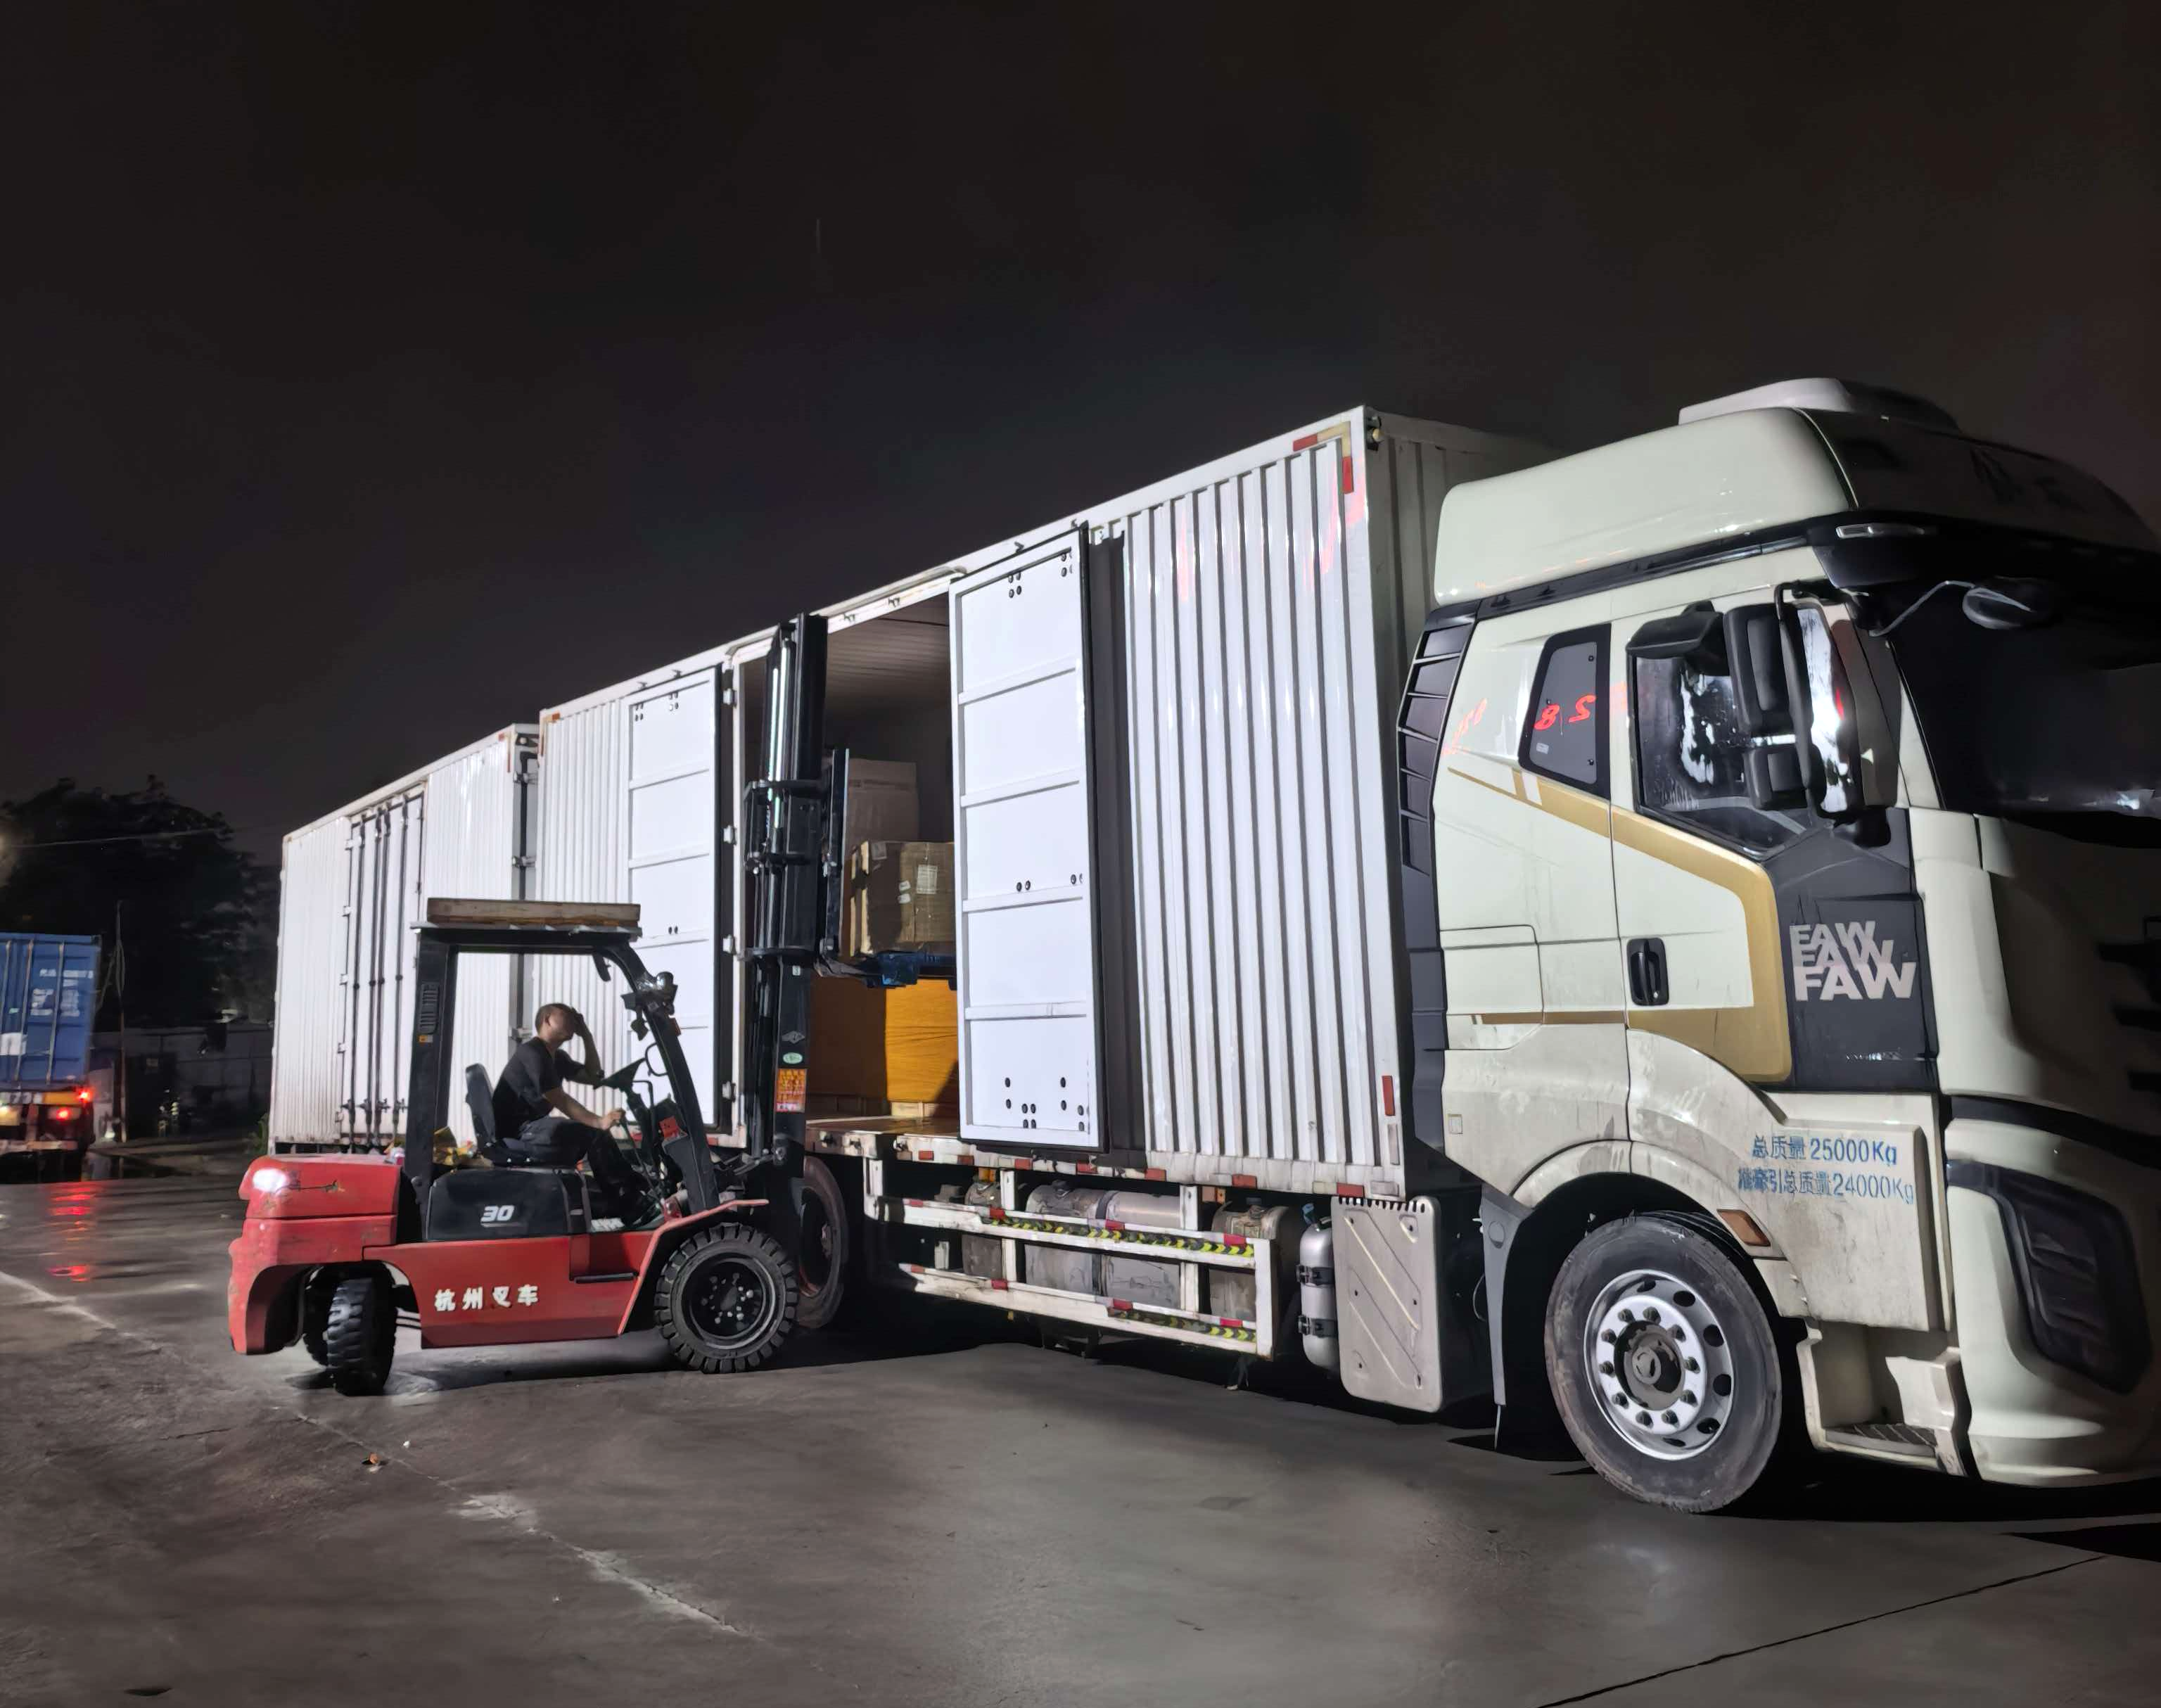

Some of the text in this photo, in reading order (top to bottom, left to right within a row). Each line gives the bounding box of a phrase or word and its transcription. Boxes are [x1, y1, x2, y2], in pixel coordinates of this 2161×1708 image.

[1794, 962, 1916, 1001] FAW
[480, 1205, 514, 1223] 30
[434, 1284, 539, 1311] 杭州叉车
